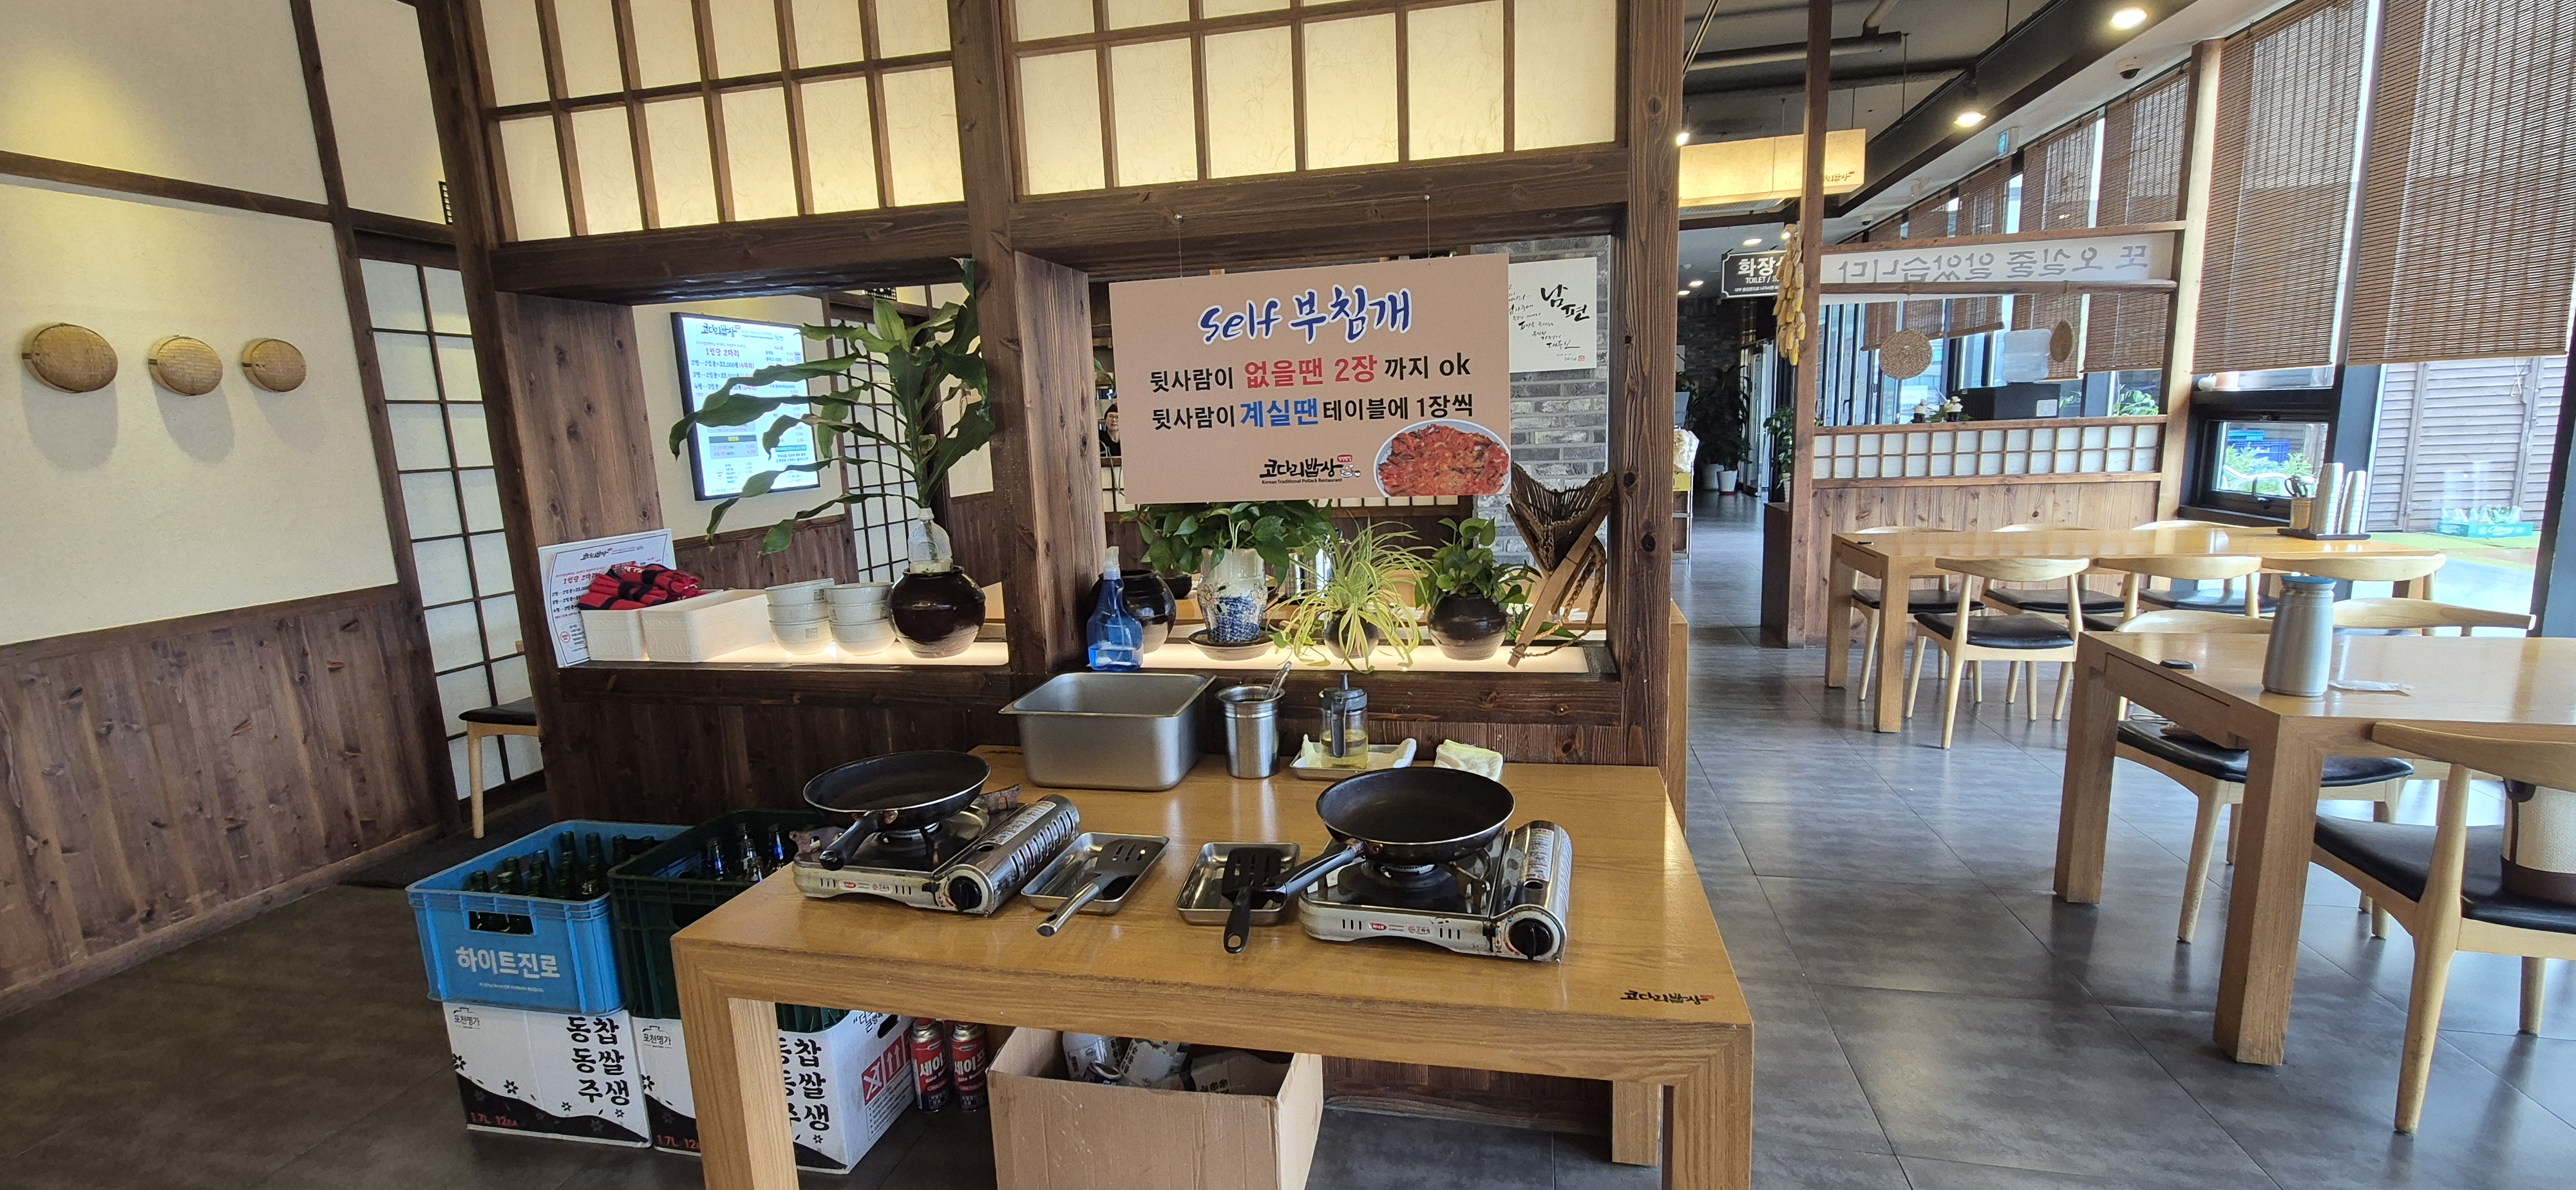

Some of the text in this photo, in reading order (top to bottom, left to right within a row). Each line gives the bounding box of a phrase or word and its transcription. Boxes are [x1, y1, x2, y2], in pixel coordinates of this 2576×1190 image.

[701, 322, 737, 337] 코다리밥상
[1289, 286, 1412, 342] 부침개
[1150, 352, 1472, 393] 뒷사람이 없을땐 2장 까지 ok
[1152, 393, 1474, 431] 뒷사람이 계실땐 테이블에 1장씩
[1259, 457, 1344, 478] 코다리밥상
[455, 947, 561, 978] 하이트진로
[1620, 990, 1709, 1005] 코다리밥상
[643, 1034, 672, 1046] 포천명가
[566, 1015, 603, 1103] 동동주
